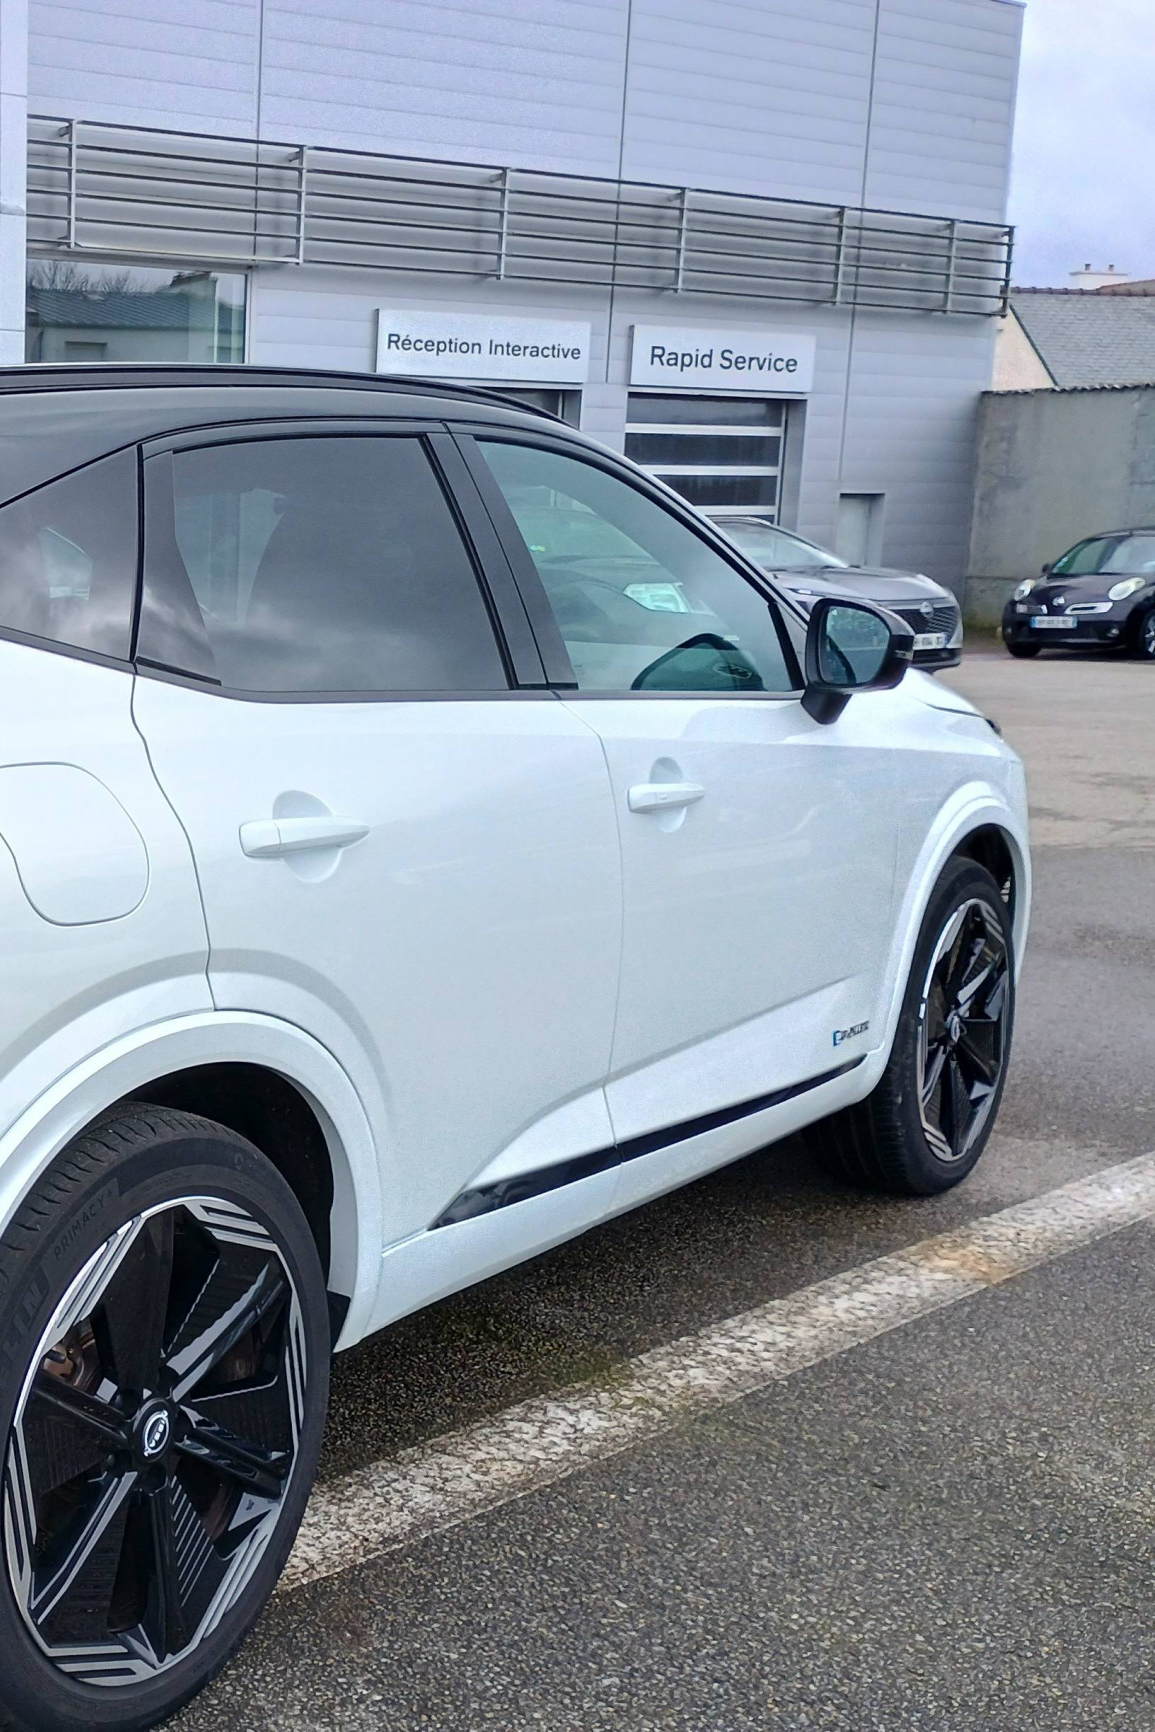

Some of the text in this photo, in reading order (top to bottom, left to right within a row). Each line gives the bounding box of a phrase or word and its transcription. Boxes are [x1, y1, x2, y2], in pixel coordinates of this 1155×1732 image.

[387, 333, 581, 360] Réception Interactive
[650, 345, 798, 373] Rapid Service
